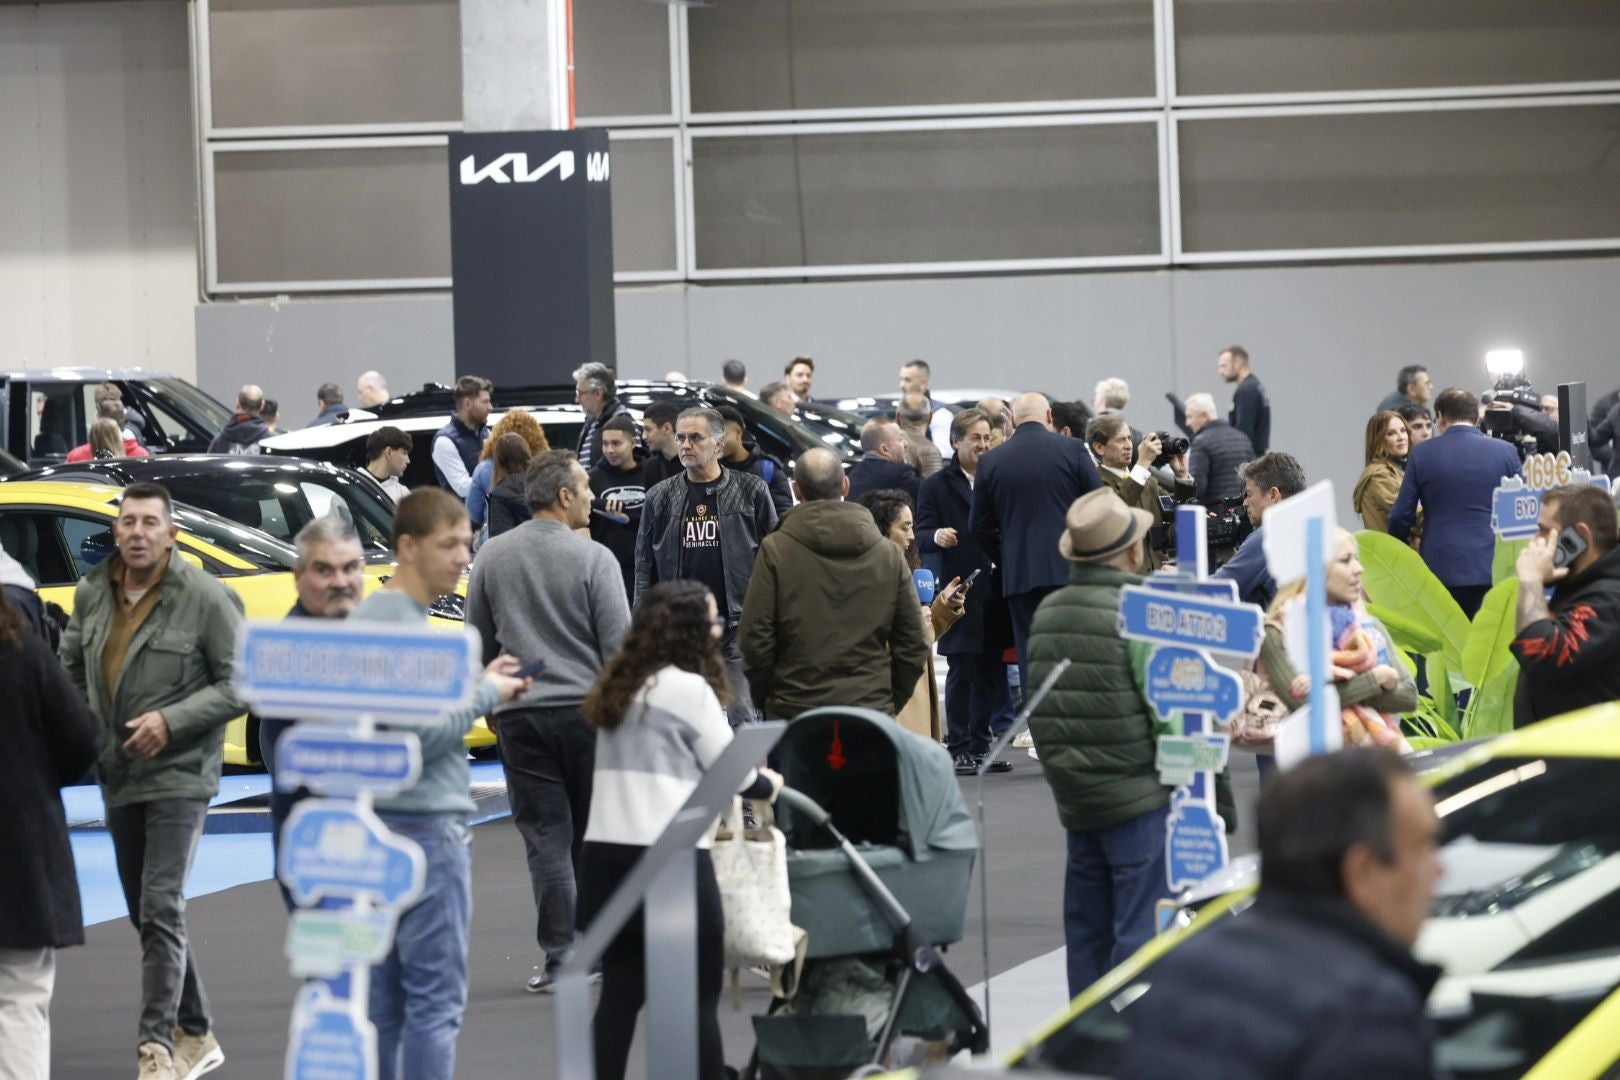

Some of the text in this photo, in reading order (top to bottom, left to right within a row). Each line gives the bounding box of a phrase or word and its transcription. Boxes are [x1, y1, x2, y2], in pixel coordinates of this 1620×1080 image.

[460, 150, 575, 184] KIA
[1523, 452, 1570, 489] 169€
[1515, 497, 1538, 519] BYD
[683, 520, 720, 544] AVO
